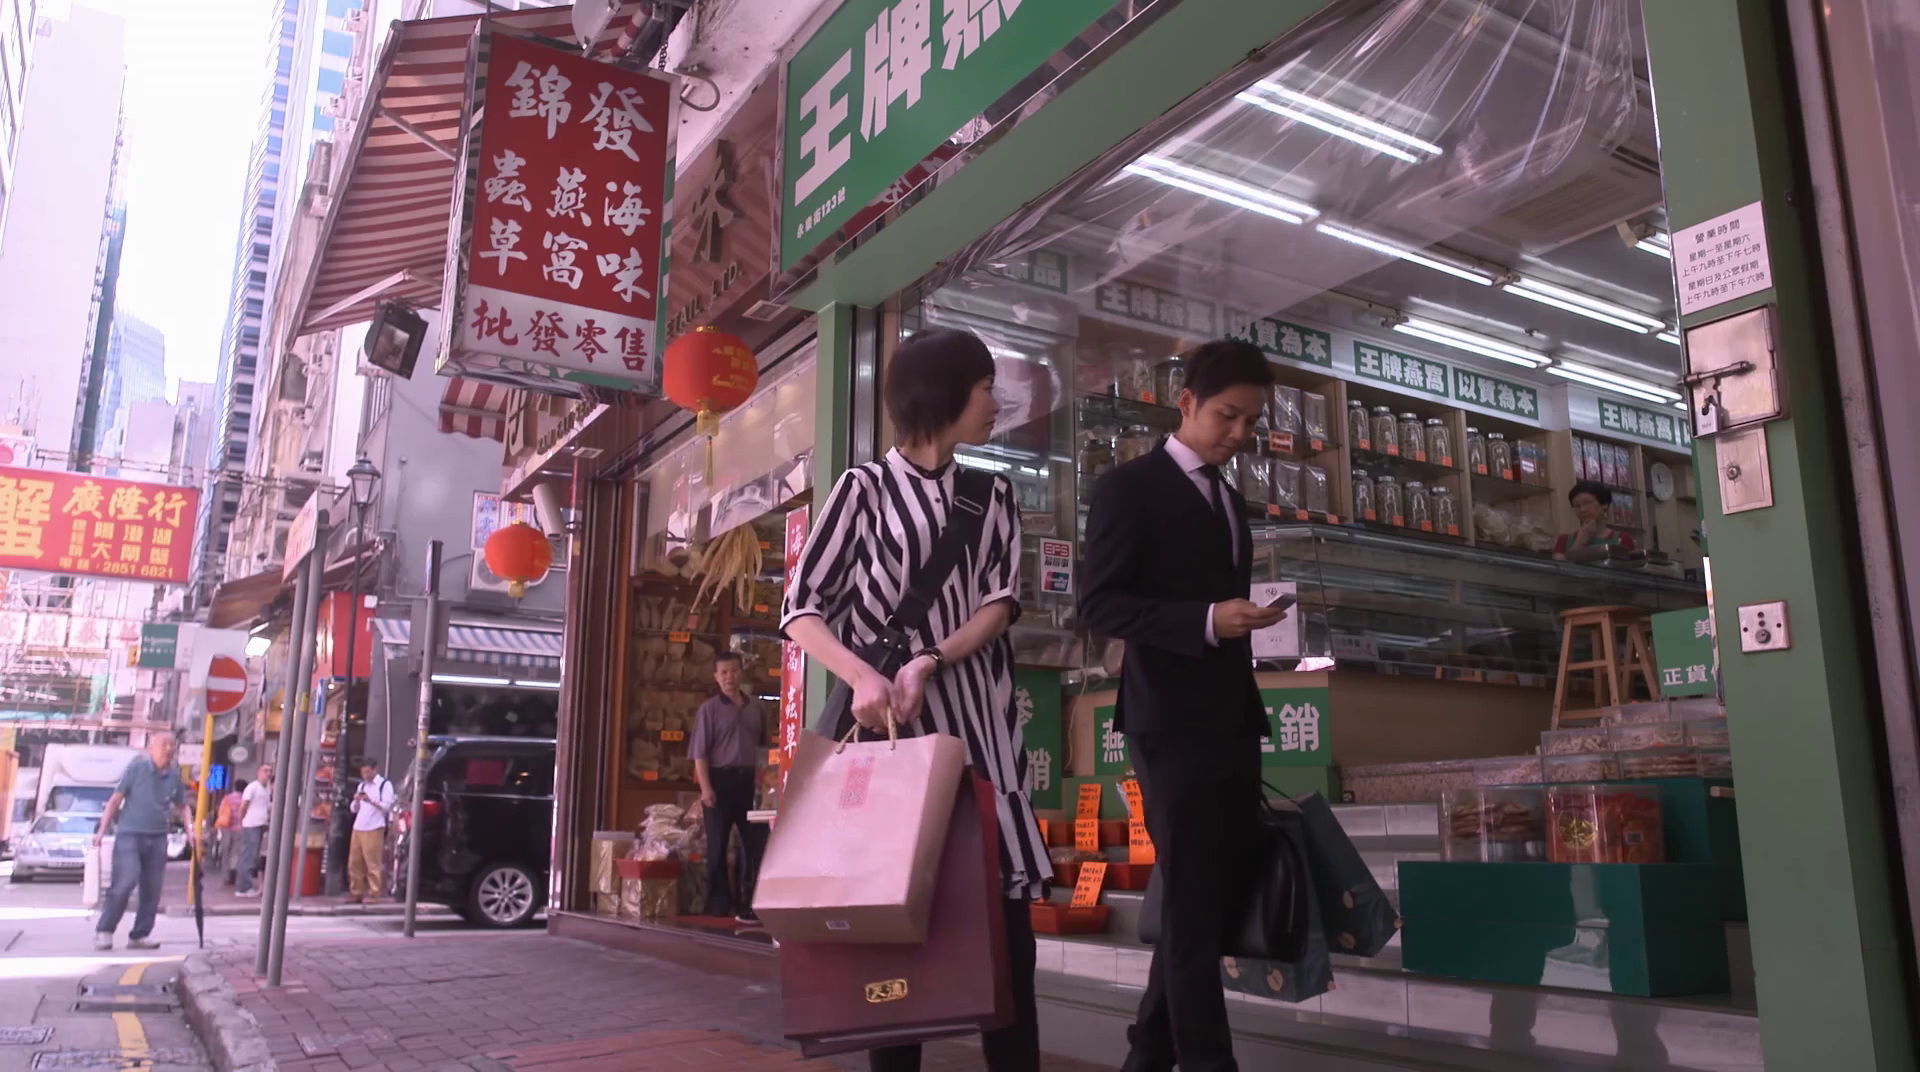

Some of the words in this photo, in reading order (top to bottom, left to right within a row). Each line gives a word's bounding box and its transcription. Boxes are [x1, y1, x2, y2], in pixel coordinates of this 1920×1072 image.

[504, 59, 655, 163] 錦發
[478, 148, 532, 276] 蟲草
[542, 166, 593, 291] 燕窩
[1695, 219, 1741, 244] 營業時間
[596, 179, 653, 303] 海味
[1682, 243, 1761, 278] 上午九時至下午七時
[1689, 234, 1751, 262] 星期一至星期六
[1686, 272, 1765, 305] 上午九時至下午六時
[1688, 260, 1759, 291] 星期日及公眾假期
[471, 298, 648, 373] 批發零售
[1359, 348, 1445, 394] 王牌燕窩
[1458, 371, 1535, 417] 以質為本
[1603, 402, 1672, 441] 王牌燕窩
[62, 479, 188, 528] 廣隆行
[1045, 543, 1069, 556] EPS
